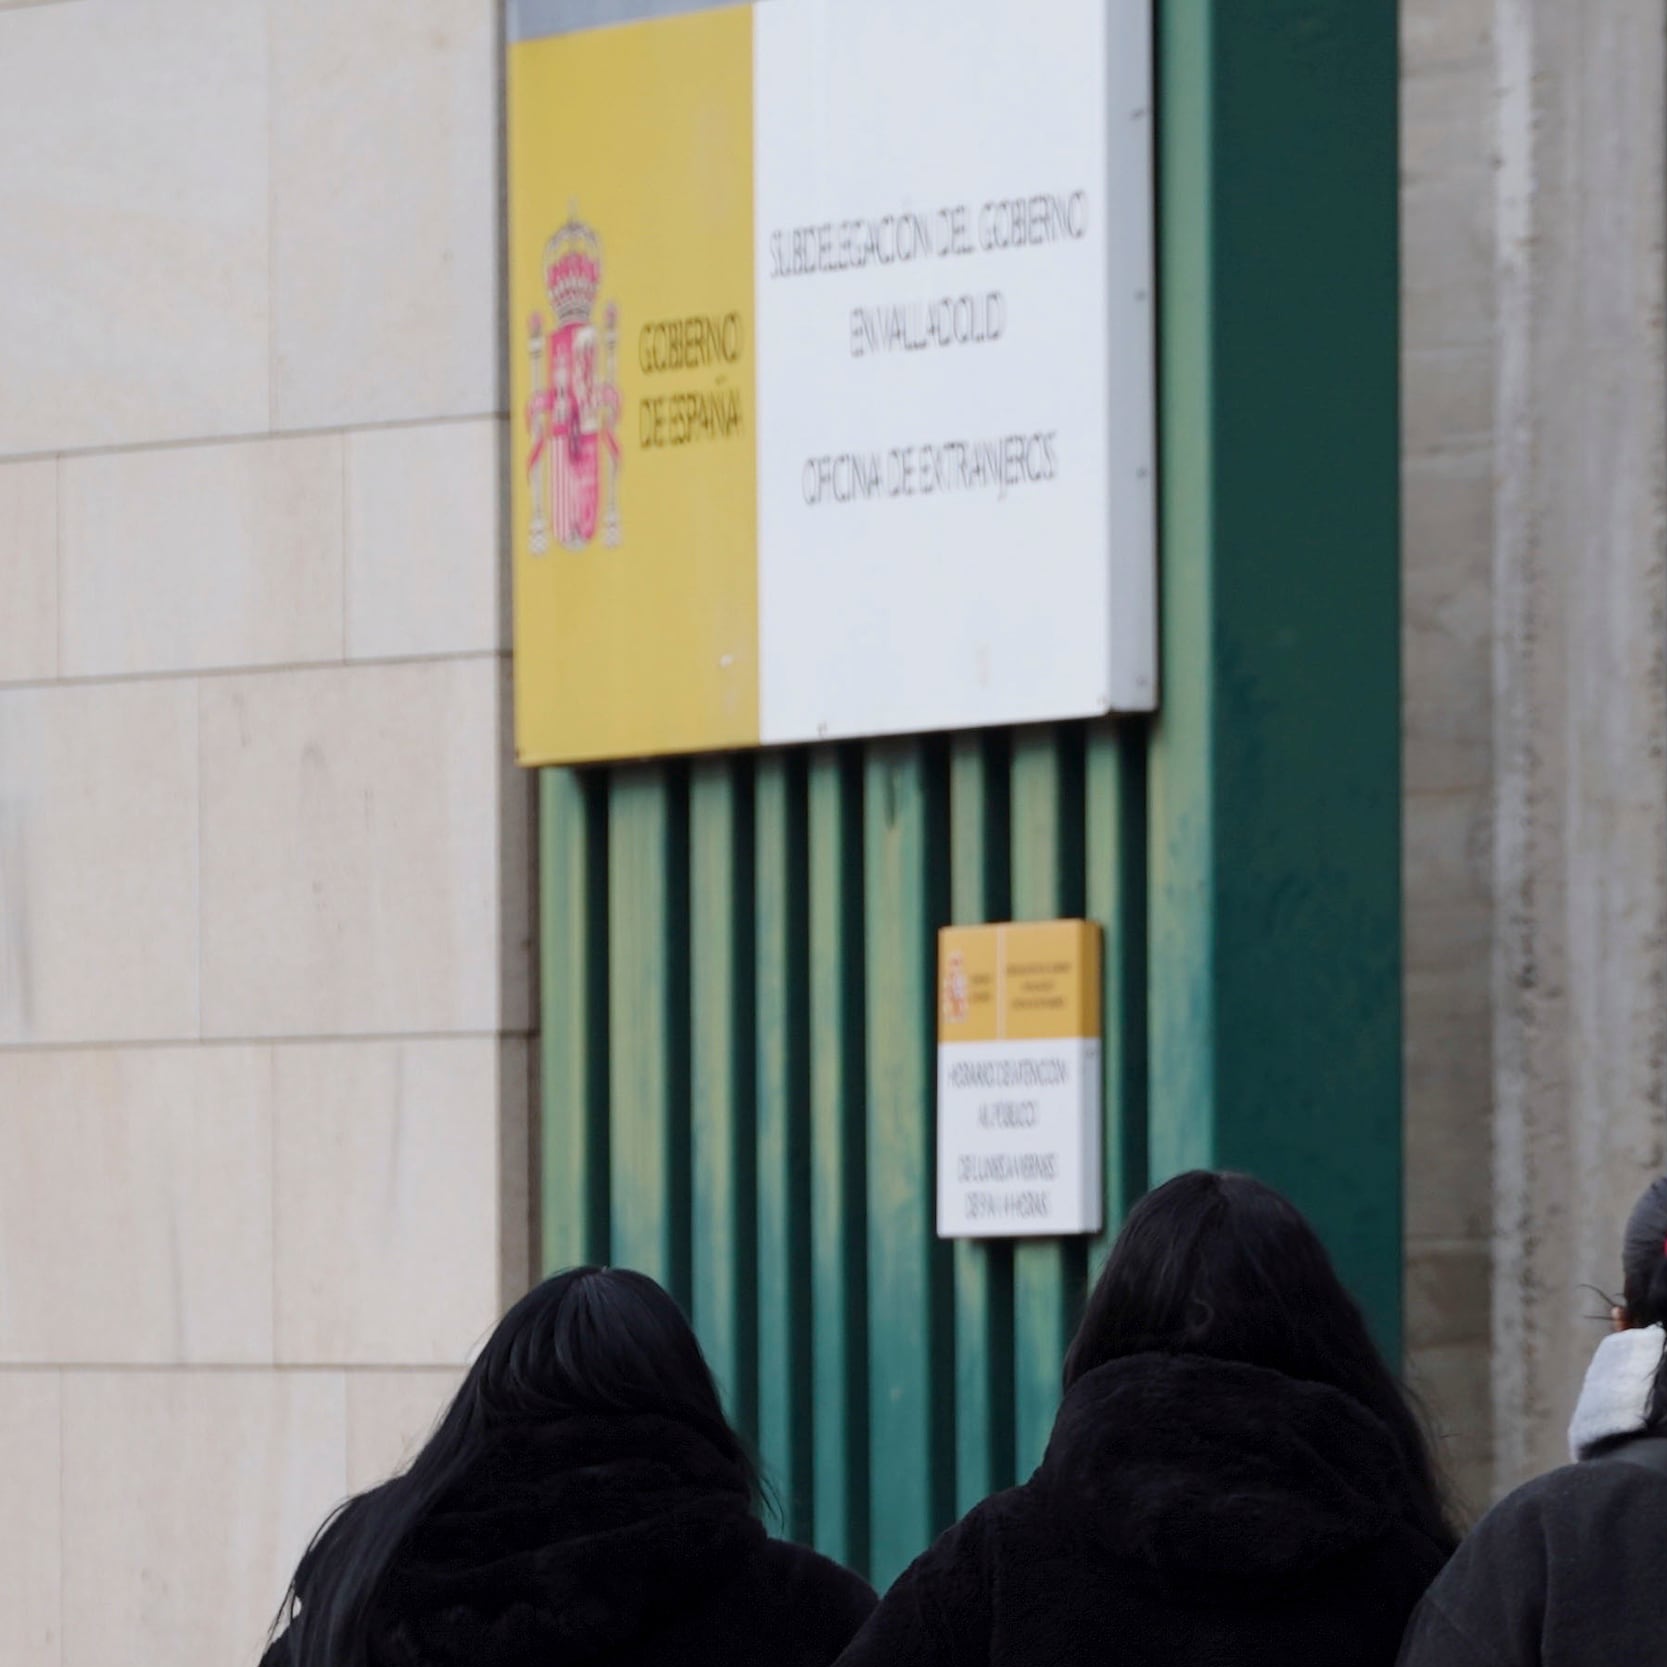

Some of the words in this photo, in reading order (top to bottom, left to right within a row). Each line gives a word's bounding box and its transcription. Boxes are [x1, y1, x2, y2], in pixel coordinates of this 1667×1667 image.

[937, 204, 975, 258] DEL
[978, 189, 1087, 252] GOBIERNO
[638, 311, 742, 375] GOBIERNO
[850, 306, 876, 358] EN
[877, 290, 1006, 353] VALLADOLID
[639, 396, 665, 450] DE
[668, 374, 742, 446] ESPAÑA
[801, 453, 883, 505] OFICINA
[888, 446, 916, 497] DE
[919, 430, 1058, 501] EXTRANJEROS
